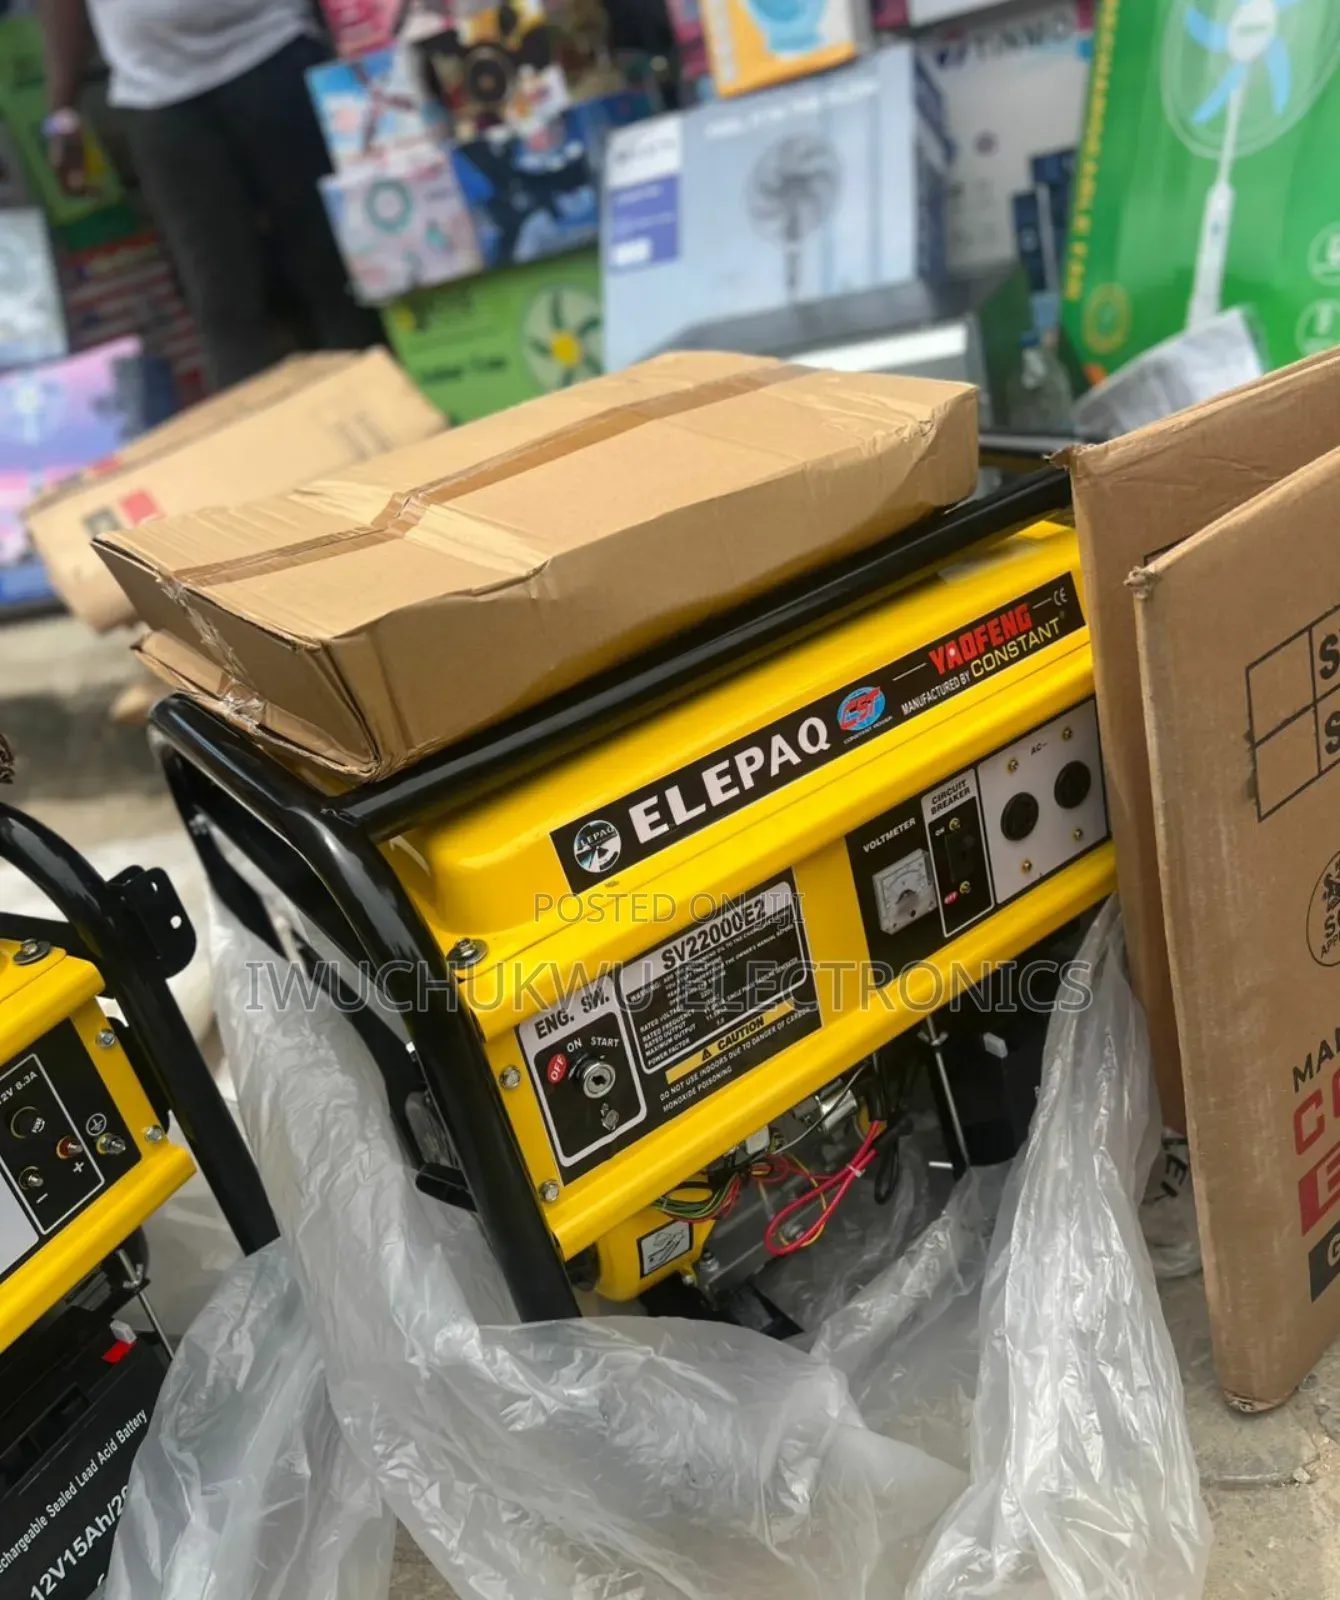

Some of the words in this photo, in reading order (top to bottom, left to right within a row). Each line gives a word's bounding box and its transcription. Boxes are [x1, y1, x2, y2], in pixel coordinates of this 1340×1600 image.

[929, 603, 1033, 675] YAOFENG
[1319, 629, 1340, 680] S
[901, 678, 960, 715] MANUFACTURED
[960, 671, 971, 686] BY
[971, 617, 1060, 678] CONSTANT
[840, 686, 880, 731] CST
[629, 716, 832, 844] ELEPAQ
[932, 779, 967, 806] CIRCUIT
[931, 787, 971, 815] BREAKER
[863, 817, 916, 853] VOLTMETER
[661, 899, 766, 972] SV22000E2
[1324, 909, 1340, 939] S
[534, 1007, 575, 1040] ENG.
[580, 985, 610, 1014] SW.
[639, 1017, 659, 1034] RATED
[642, 1027, 661, 1043] RATED
[662, 1008, 694, 1032] FREQUENCY
[566, 1037, 583, 1053] ON
[590, 1036, 620, 1048] START
[643, 1034, 663, 1050] RATED
[663, 1020, 686, 1038] OUTPUT
[645, 1036, 672, 1057] MAXIMUM
[673, 1023, 696, 1040] OUTPUT
[717, 1016, 765, 1051] CAUTION
[550, 1055, 565, 1081] OFF
[647, 1049, 667, 1066] POWER
[668, 1037, 689, 1054] FACTOR
[659, 1089, 669, 1101] DO
[670, 1080, 684, 1095] NOT
[684, 1072, 698, 1086] USE
[699, 1054, 728, 1077] INDOORS
[728, 1046, 740, 1060] DUE
[742, 1040, 751, 1051] TO
[751, 1025, 776, 1046] DANGER
[776, 1020, 785, 1031] OF
[662, 1086, 696, 1113] MONOXIDE
[697, 1064, 732, 1091] POISONING
[46, 1481, 78, 1518] Sealed
[75, 1459, 99, 1488] Lead
[97, 1438, 118, 1466] Acid
[115, 1409, 148, 1444] Battery
